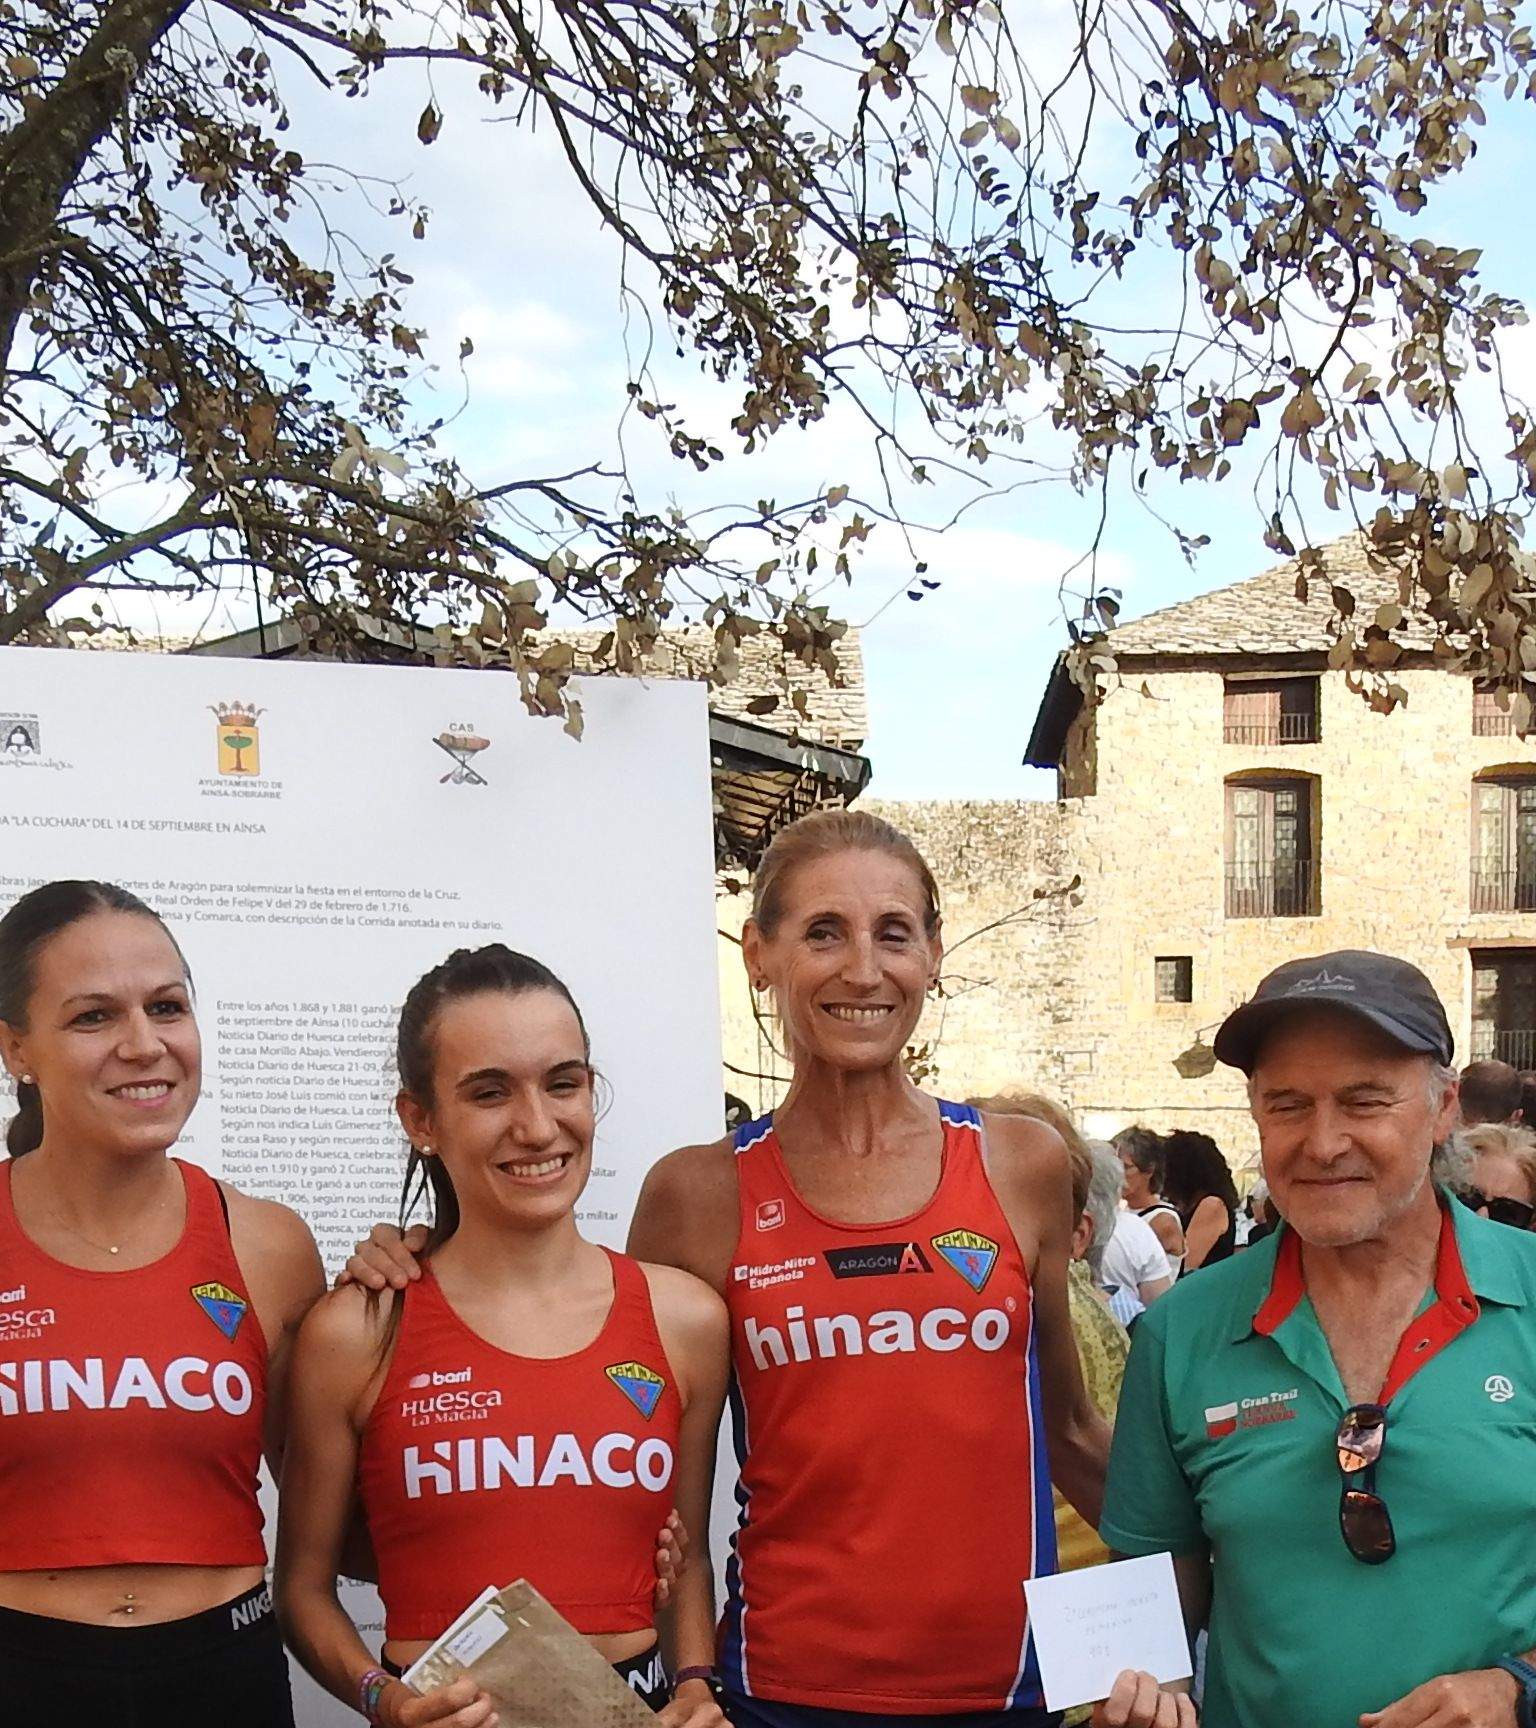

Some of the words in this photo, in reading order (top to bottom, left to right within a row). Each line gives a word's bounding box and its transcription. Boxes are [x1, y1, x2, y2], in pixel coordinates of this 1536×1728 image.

[449, 722, 474, 733] CAS
[198, 779, 268, 789] AYUNTAMIENTO
[271, 781, 283, 789] DE
[11, 815, 29, 826] "LA
[32, 816, 90, 828] CUCHARA"
[92, 818, 113, 829] DEL
[116, 819, 128, 828] 14
[131, 819, 145, 830] DE
[148, 820, 212, 832] SEPTIEMBRE
[216, 822, 230, 832] EN
[233, 822, 266, 833] AÍNSA
[115, 879, 149, 890] Cortes
[152, 880, 165, 889] de
[168, 880, 207, 893] Aragón
[210, 883, 233, 893] para
[236, 882, 292, 893] solemnizar
[295, 884, 304, 894] la
[306, 885, 334, 895] fiesta
[352, 886, 361, 896] el
[364, 888, 406, 897] entorno
[408, 888, 420, 898] de
[424, 888, 432, 898] la
[434, 889, 460, 899] Cruz.
[155, 894, 177, 904] Real
[180, 895, 213, 906] Orden
[216, 896, 229, 906] de
[232, 896, 263, 909] Felipe
[265, 898, 272, 907] V
[275, 898, 291, 908] del
[294, 899, 306, 909] 29
[309, 899, 323, 909] de
[325, 900, 363, 911] febrero
[365, 902, 379, 911] de
[381, 902, 412, 912] 1.716.
[185, 913, 191, 922] y
[194, 910, 243, 922] Comarca,
[245, 914, 265, 922] con
[268, 913, 328, 925] descripción
[330, 915, 343, 924] de
[346, 915, 355, 925] la
[357, 916, 395, 926] Corrida
[398, 917, 439, 927] anotada
[442, 920, 455, 928] en
[472, 920, 502, 930] diario.
[216, 1000, 244, 1010] Entre
[246, 1001, 261, 1011] los
[264, 1001, 289, 1011] años
[292, 1002, 319, 1012] 1.868
[322, 1005, 328, 1014] y
[332, 1003, 357, 1012] 1.881
[360, 1004, 387, 1015] ganó
[749, 1256, 816, 1277] Hidro-Nitro
[838, 1255, 897, 1271] ARAGÓN
[749, 1270, 804, 1289] Española
[744, 1305, 1010, 1371] hinaco
[403, 1432, 674, 1499] HINACO
